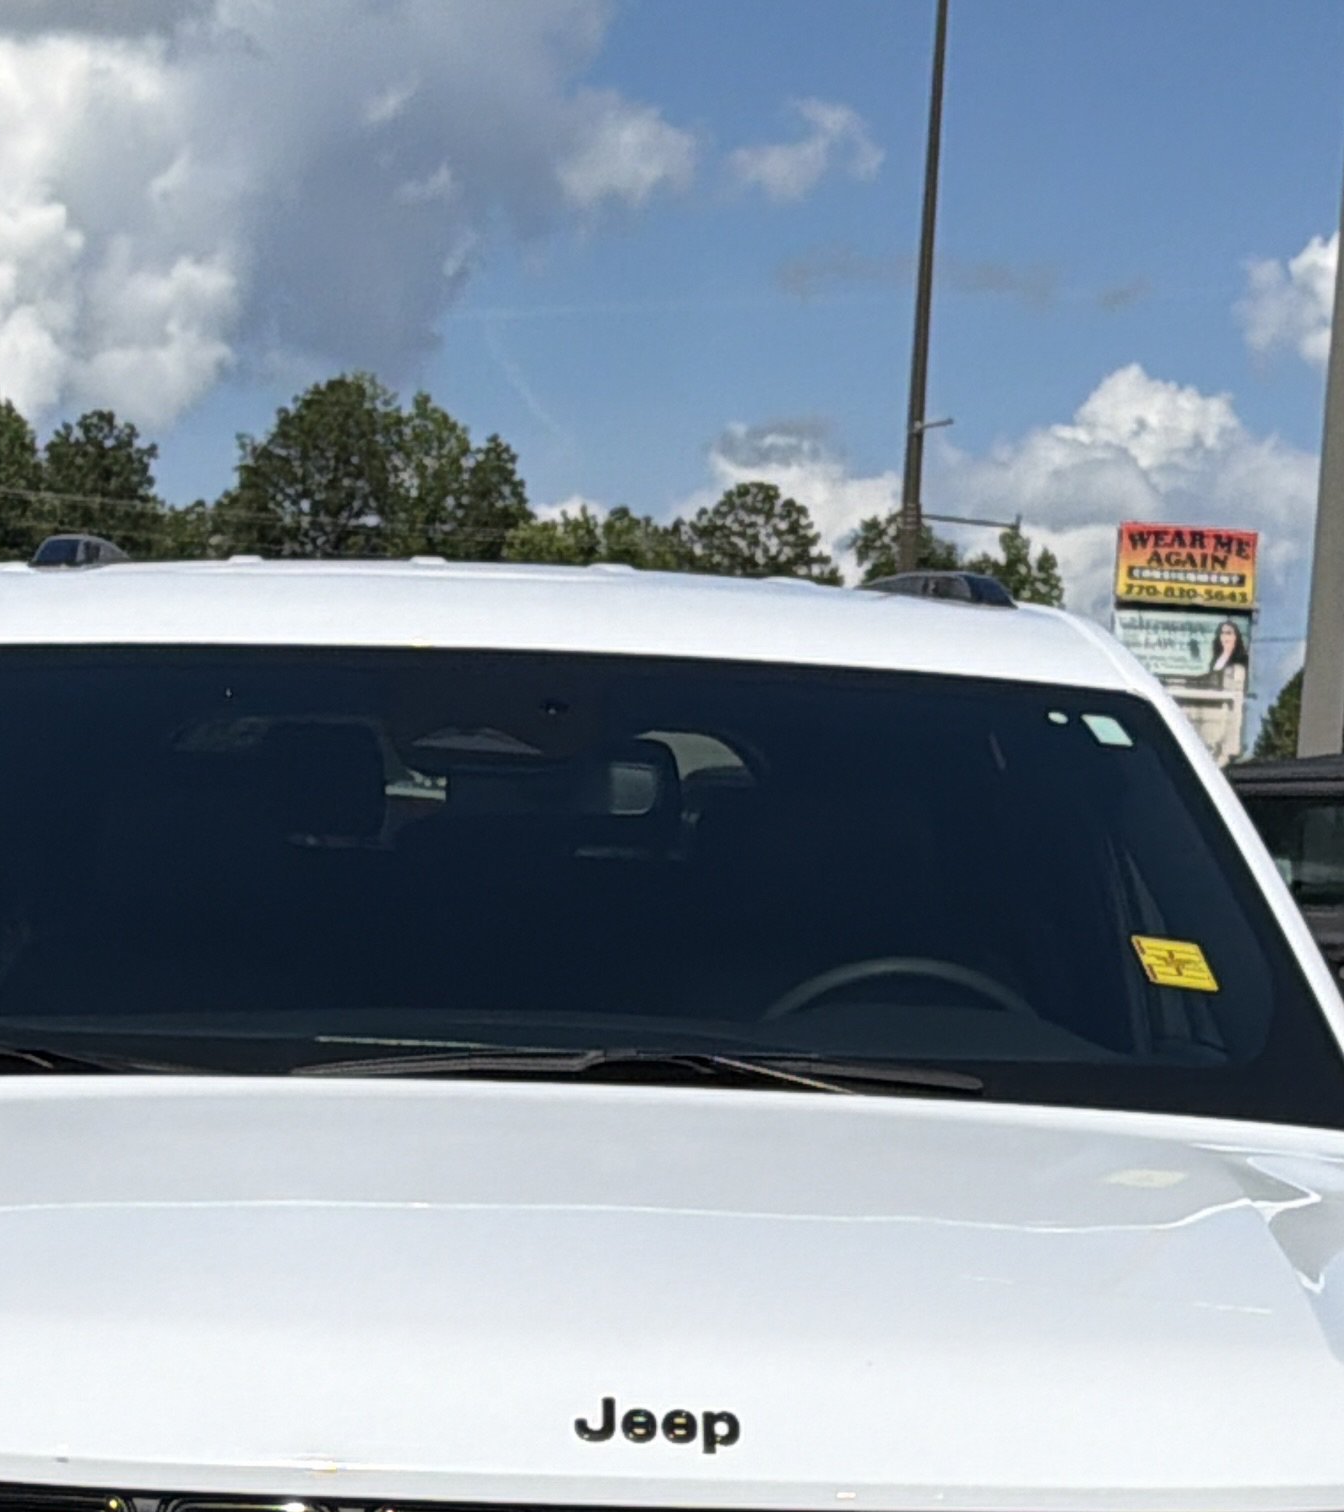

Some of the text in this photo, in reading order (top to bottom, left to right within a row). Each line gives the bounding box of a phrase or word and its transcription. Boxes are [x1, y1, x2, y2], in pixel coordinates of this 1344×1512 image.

[1128, 530, 1251, 561] WEAR ME
[1146, 550, 1229, 571] AGAIN
[573, 1396, 741, 1454] Jeep
